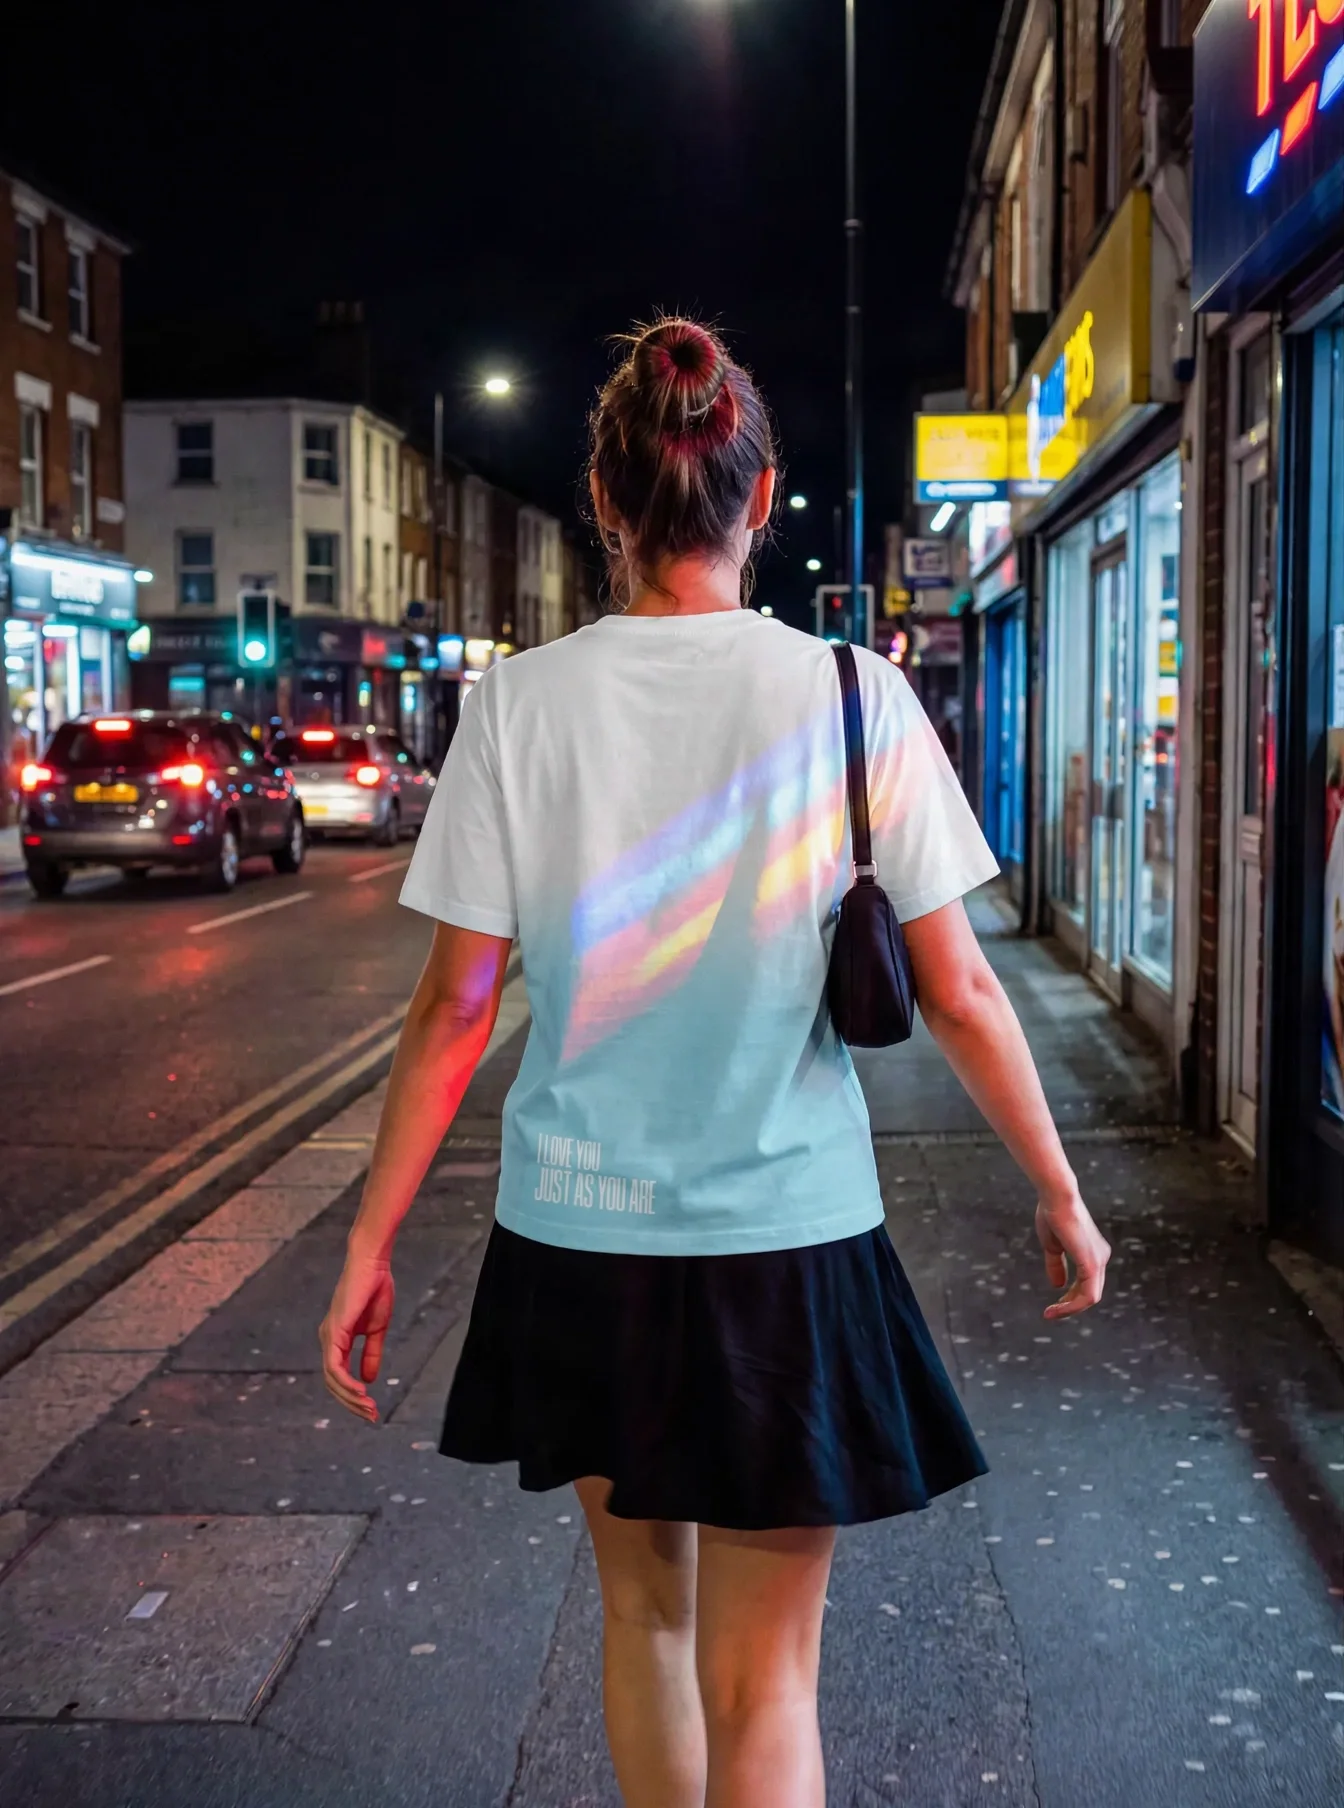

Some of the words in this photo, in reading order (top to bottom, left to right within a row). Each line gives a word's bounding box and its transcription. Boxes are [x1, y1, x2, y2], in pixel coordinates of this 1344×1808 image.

[537, 1132, 543, 1164] I
[543, 1134, 574, 1168] LOVE
[576, 1139, 601, 1172] YOU
[534, 1167, 572, 1205] JUST
[573, 1172, 595, 1208] AS
[598, 1175, 627, 1212] YOU
[628, 1178, 657, 1215] ARE
